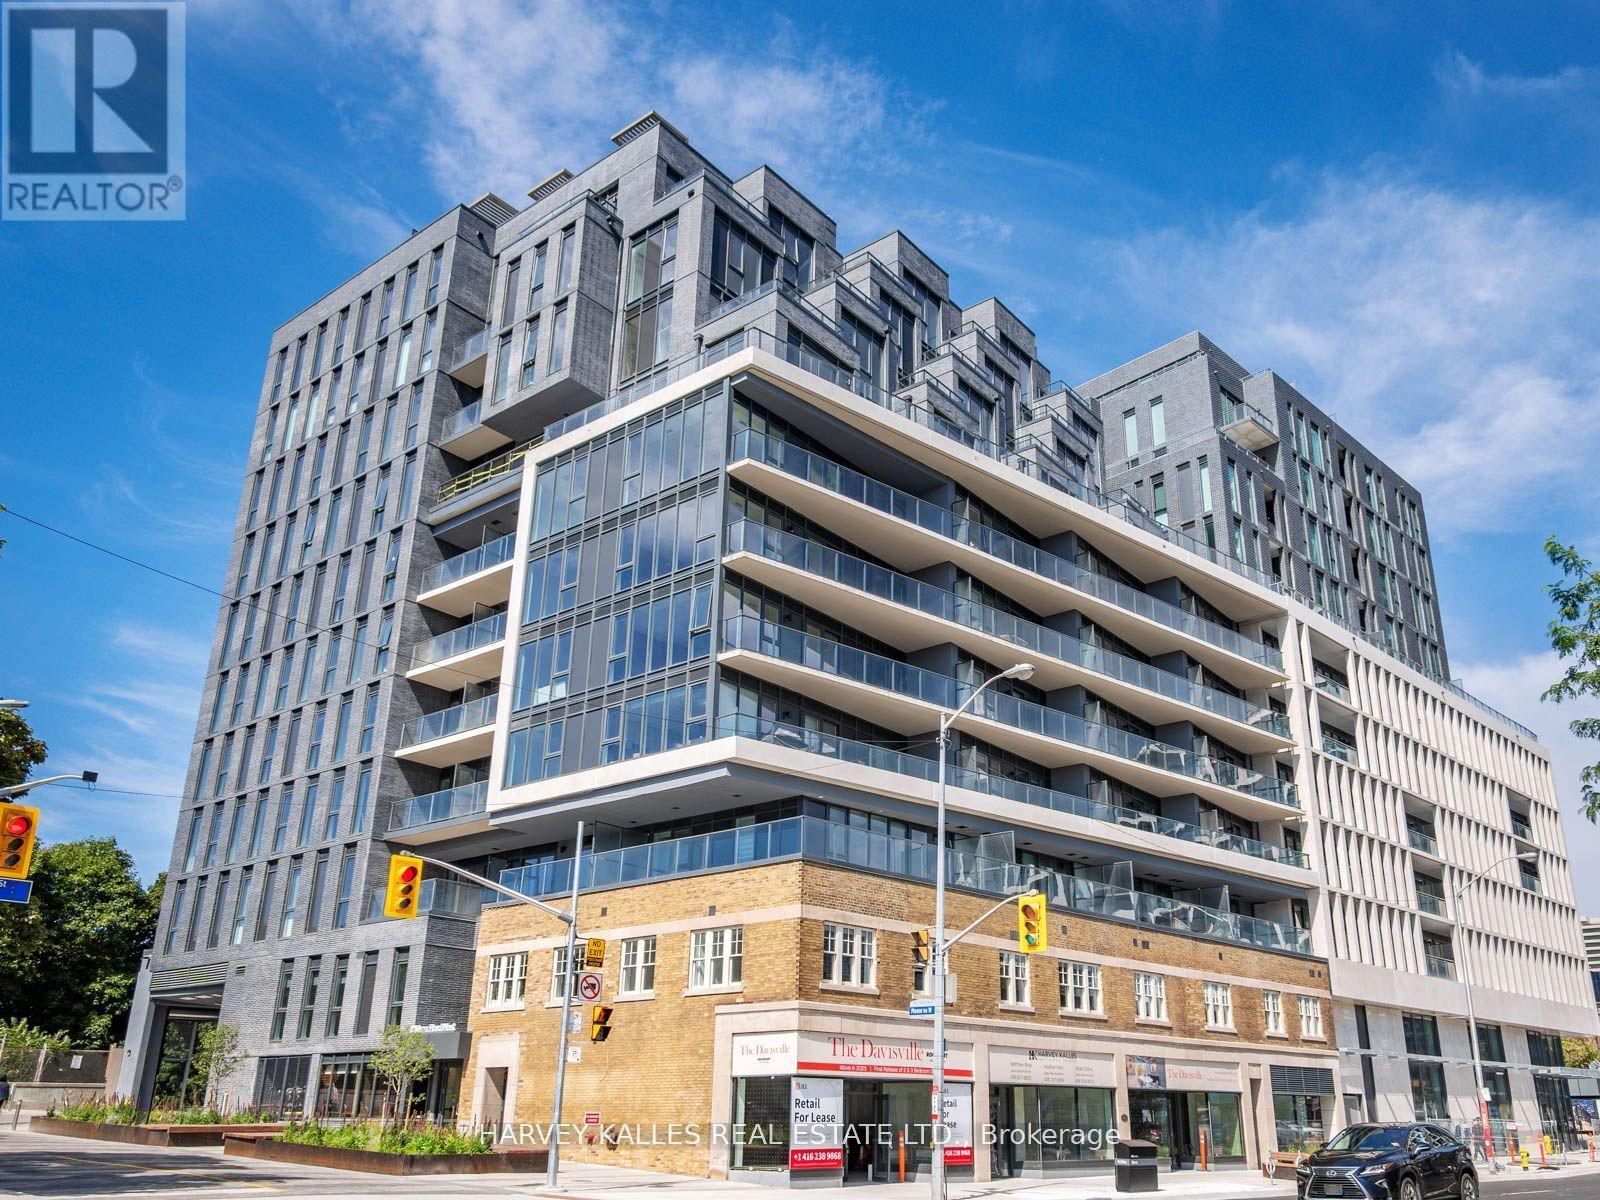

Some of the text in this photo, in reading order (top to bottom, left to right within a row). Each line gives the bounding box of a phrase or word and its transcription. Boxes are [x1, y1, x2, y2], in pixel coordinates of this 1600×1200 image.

[592, 940, 602, 948] NO
[741, 1045, 755, 1055] The
[828, 1036, 924, 1061] The Davisville
[794, 1098, 820, 1109] Retail
[942, 1098, 957, 1108] etail
[794, 1112, 836, 1123] For Lease
[943, 1121, 957, 1129] ease
[801, 1152, 814, 1161] 416
[814, 1152, 826, 1161] 238
[826, 1151, 842, 1160] 9868
